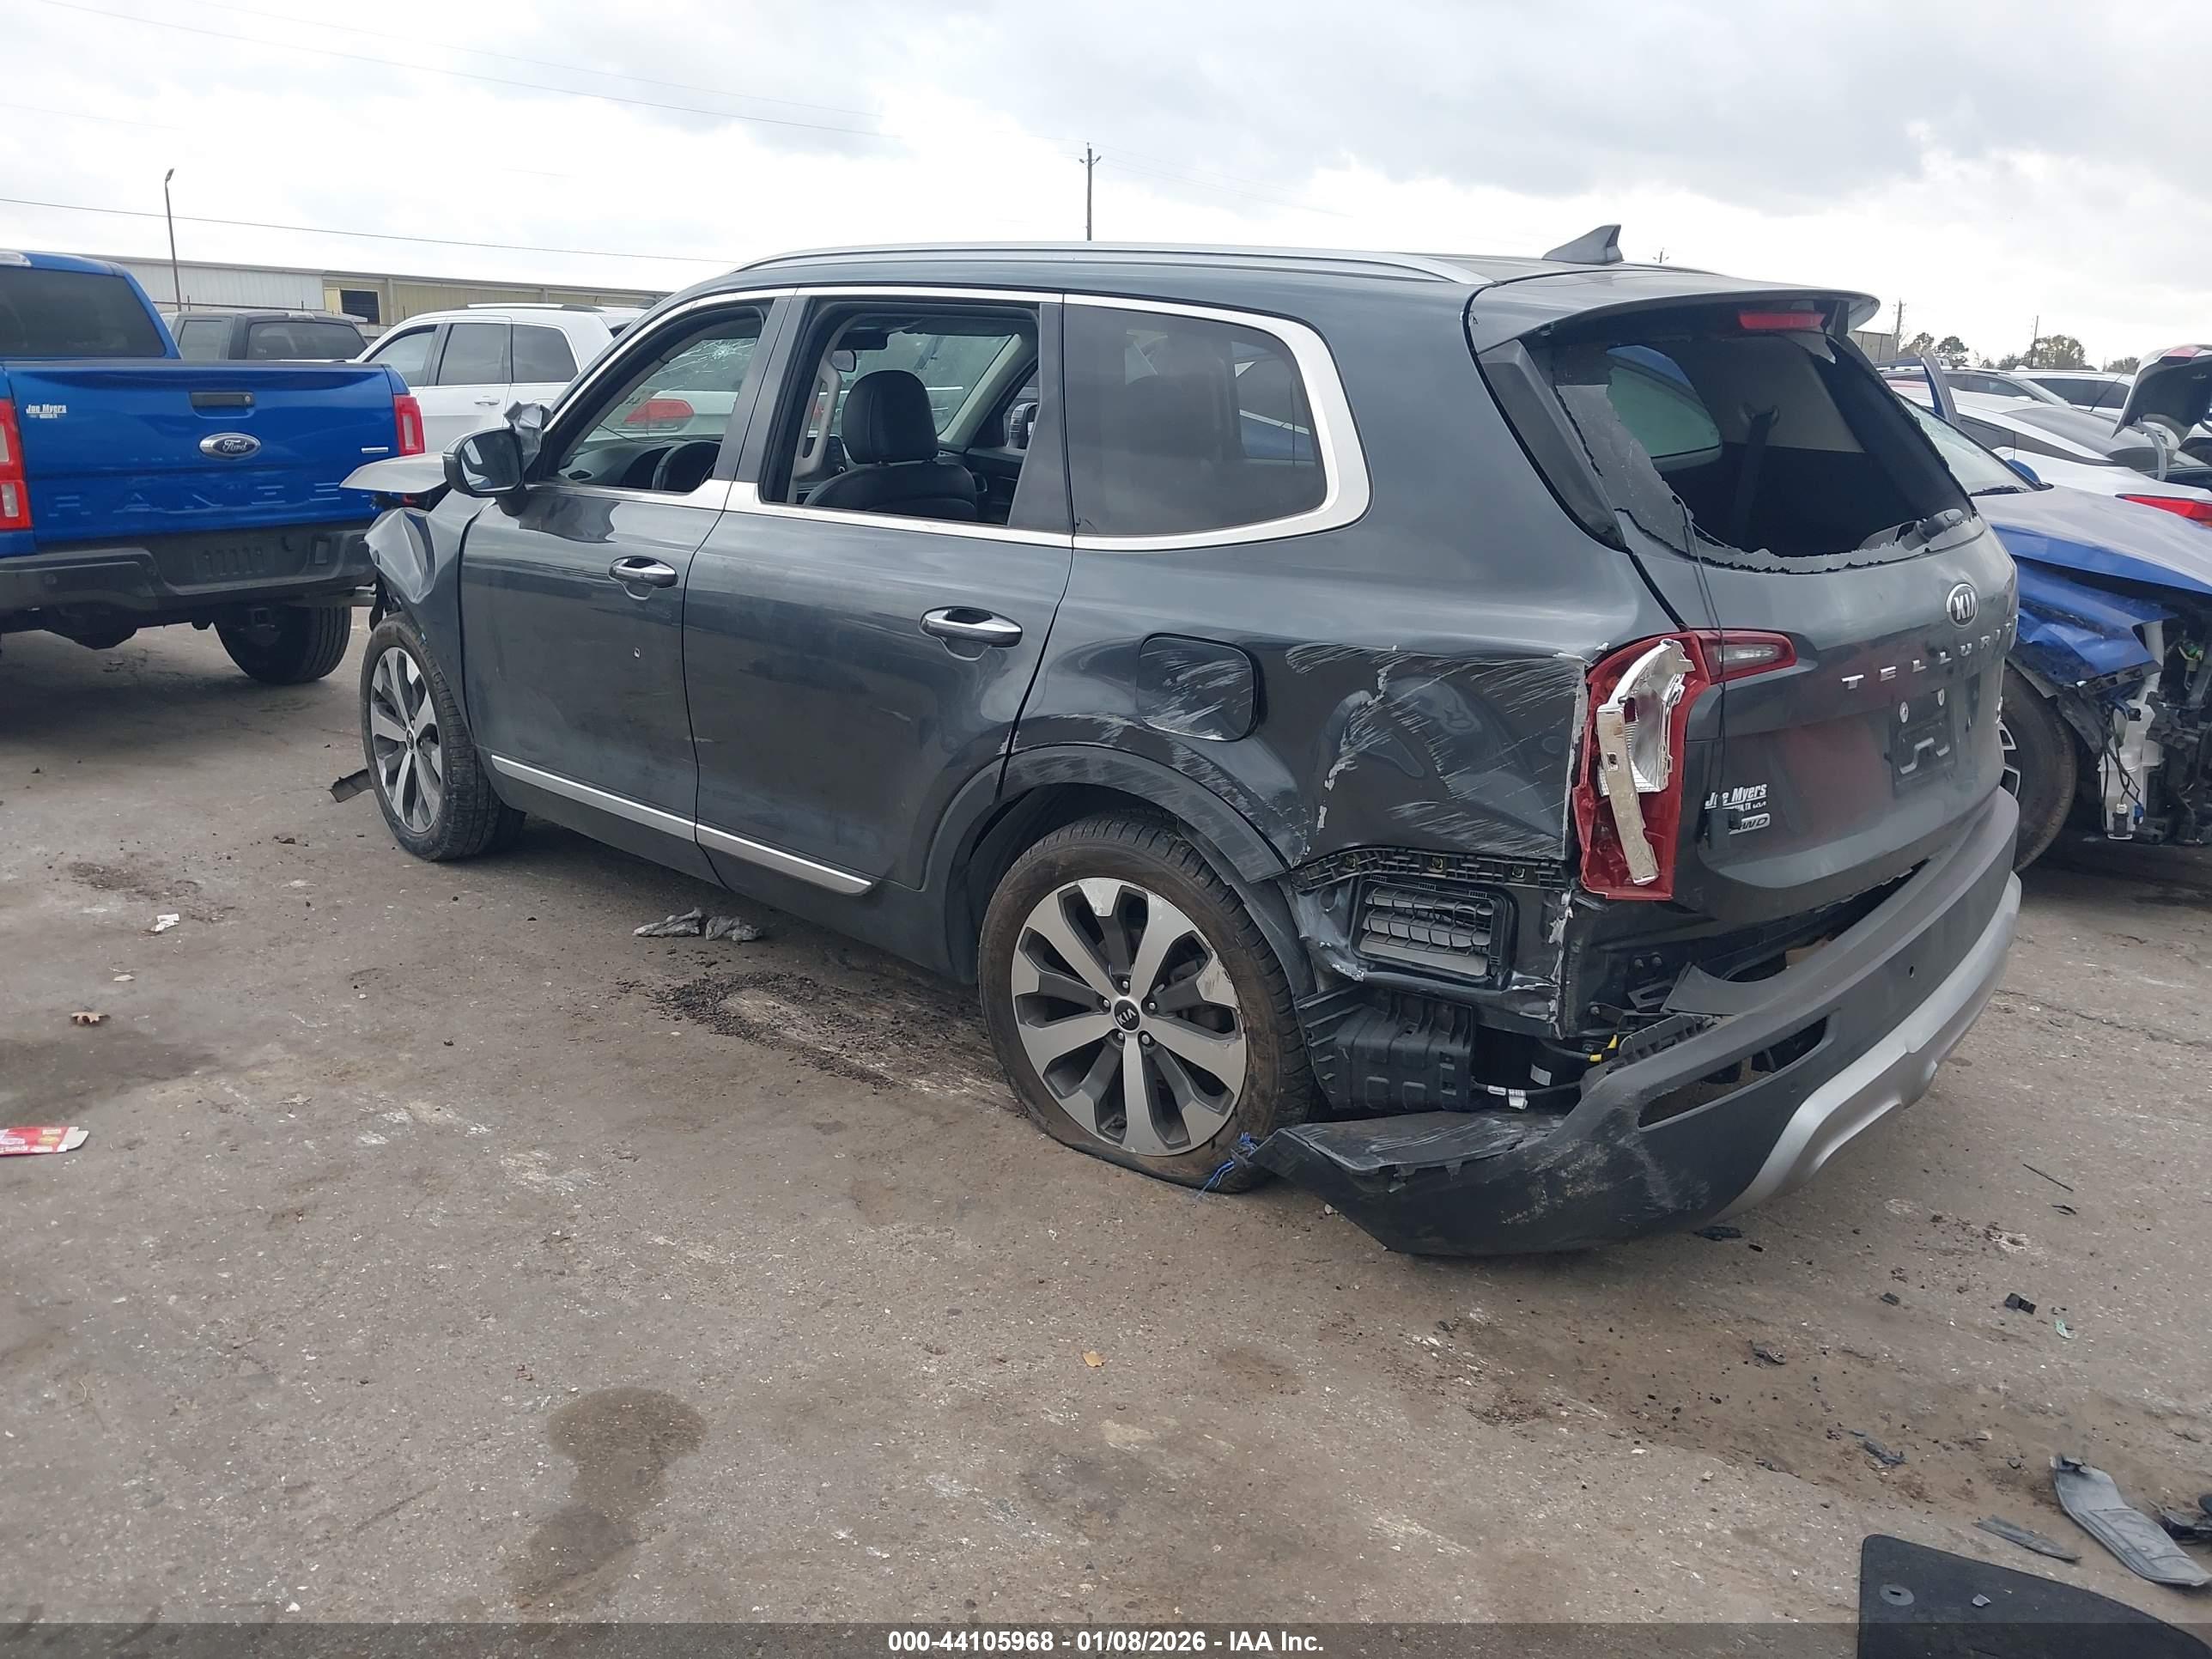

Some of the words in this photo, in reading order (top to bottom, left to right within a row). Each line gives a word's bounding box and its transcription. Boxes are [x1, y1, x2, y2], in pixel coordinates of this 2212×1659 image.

[222, 439, 247, 453] Ford
[48, 482, 369, 517] RANGE
[1731, 783, 1768, 802] Myers
[1116, 1008, 1137, 1025] KIA
